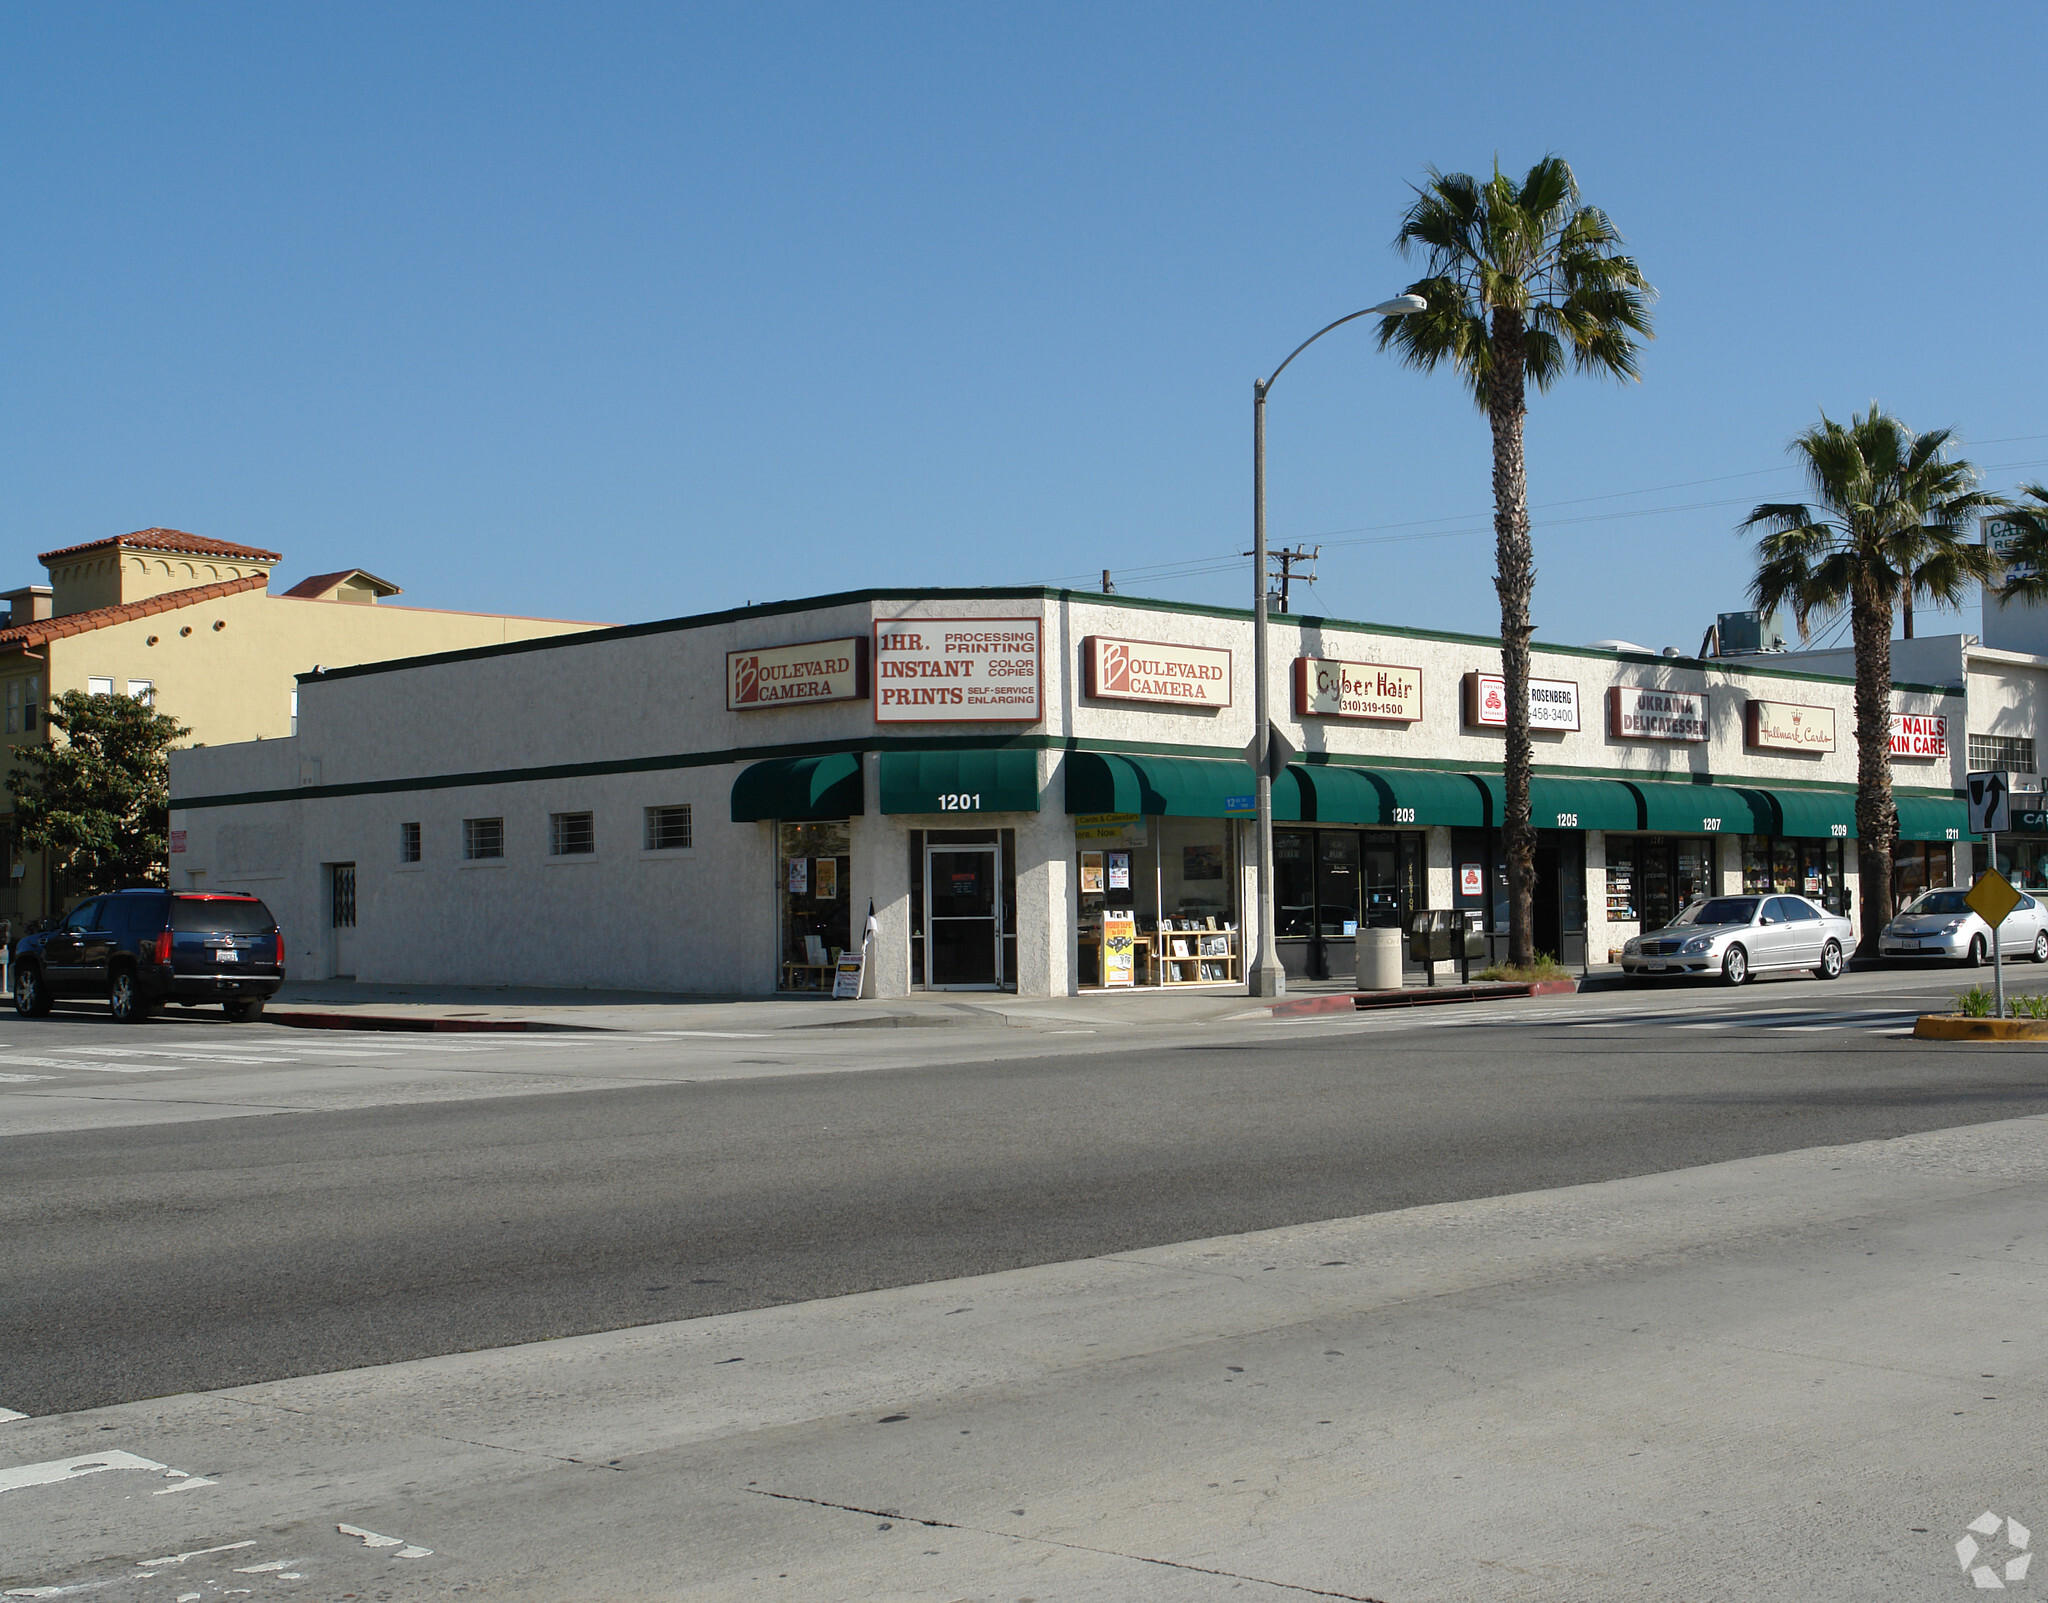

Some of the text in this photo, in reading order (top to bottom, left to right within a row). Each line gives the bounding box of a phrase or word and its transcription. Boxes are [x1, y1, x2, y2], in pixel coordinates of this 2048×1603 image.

[881, 634, 930, 650] 1HR.
[945, 632, 1035, 642] PROCESSING
[945, 643, 1035, 654] PRINTING
[881, 660, 974, 678] INSTANT
[988, 660, 1034, 668] COLOR
[988, 668, 1034, 676] COPIES
[758, 682, 833, 702] CAMERA
[1130, 678, 1208, 699] CAMERA
[1317, 669, 1412, 702] Cyber Hair
[882, 688, 963, 705] PRINTS
[968, 696, 1034, 704] ENLARGING
[1531, 688, 1572, 704] ROSENBERG
[1638, 695, 1693, 714] UKRAINA
[1624, 714, 1708, 735] DELICATESSEN
[1761, 721, 1804, 742] Hallmark
[1902, 717, 1945, 736] NAILS
[1889, 735, 1945, 754] KIN CARE
[938, 794, 981, 810] 1201
[1391, 808, 1415, 823] 1203
[1556, 814, 1578, 827] 1205
[2023, 813, 2048, 824] CA
[1703, 818, 1721, 831] 1207
[1831, 825, 1847, 837] 1209
[1097, 829, 1117, 837] Now.
[1946, 828, 1959, 839] 1211
